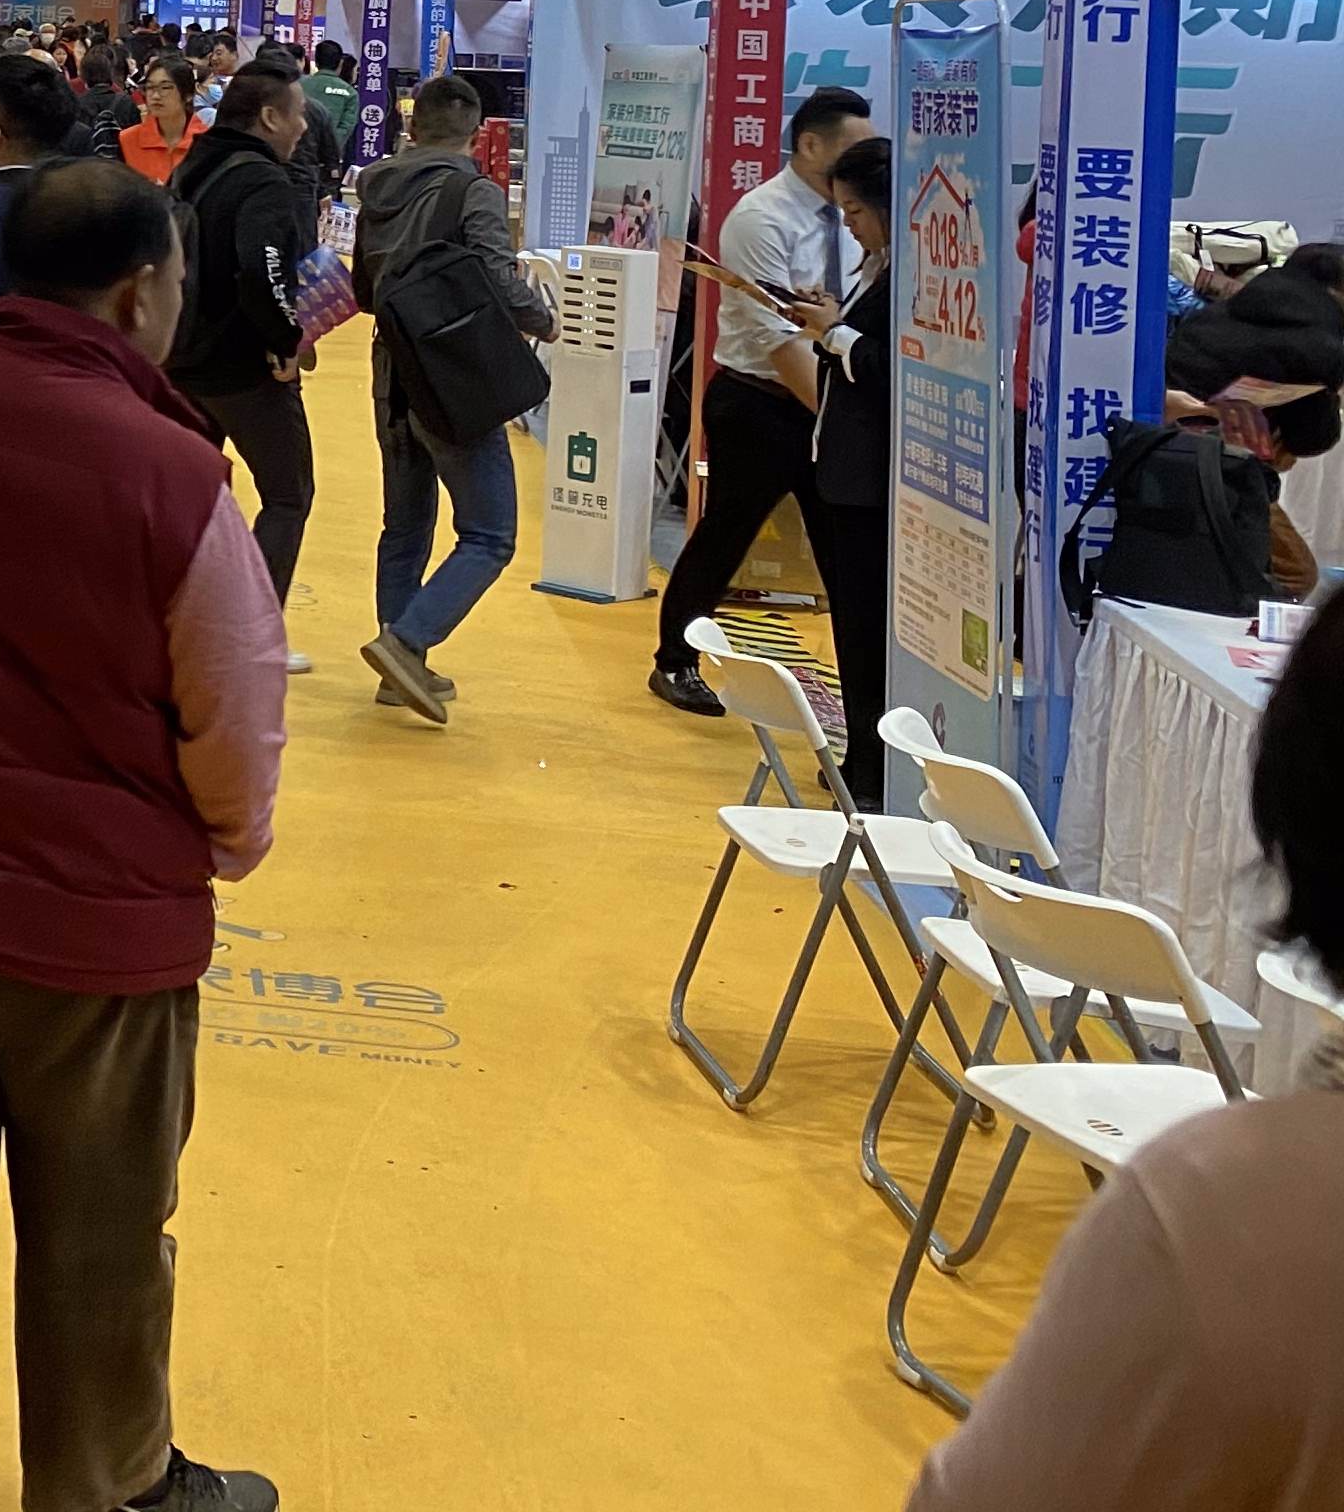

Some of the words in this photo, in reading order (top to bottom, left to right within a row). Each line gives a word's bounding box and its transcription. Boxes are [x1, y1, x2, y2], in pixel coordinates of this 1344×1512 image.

[364, 40, 388, 92] 抽免单
[361, 105, 385, 158] 送好礼
[912, 89, 978, 137] 建行家装节
[1069, 145, 1135, 338] 要装修
[213, 1032, 347, 1058] SAVE
[359, 1050, 462, 1070] MONEY
